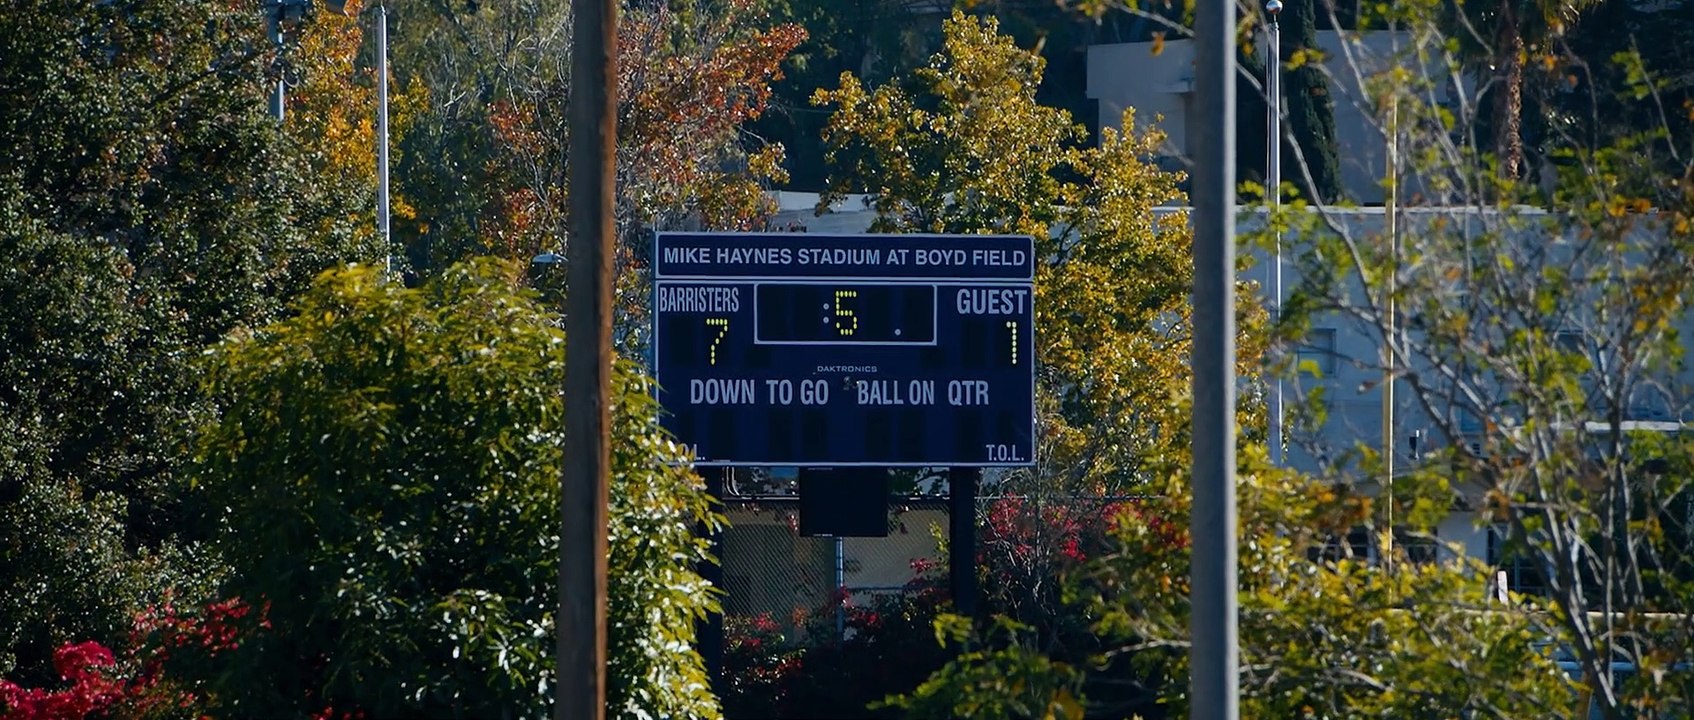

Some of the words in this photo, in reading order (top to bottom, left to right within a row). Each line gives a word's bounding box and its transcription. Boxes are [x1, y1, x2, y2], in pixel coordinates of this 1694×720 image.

[664, 247, 711, 264] MIKE
[716, 247, 793, 265] HAYNES
[798, 248, 880, 265] STADIUM
[886, 249, 910, 265] AT
[915, 249, 967, 266] BOYD
[972, 250, 1026, 266] FIELD
[659, 286, 740, 313] BARRISTERS
[956, 288, 1028, 315] GUEST
[705, 318, 728, 365] 7
[1006, 321, 1017, 365] 1
[817, 365, 878, 373] DAKTRONICS
[690, 378, 755, 405] DOWN
[765, 379, 793, 405] TO
[800, 379, 829, 405] GO
[857, 380, 904, 406] BALL
[909, 379, 935, 406] ON
[948, 380, 990, 407] QTR
[985, 444, 1025, 462] T.O.L.
